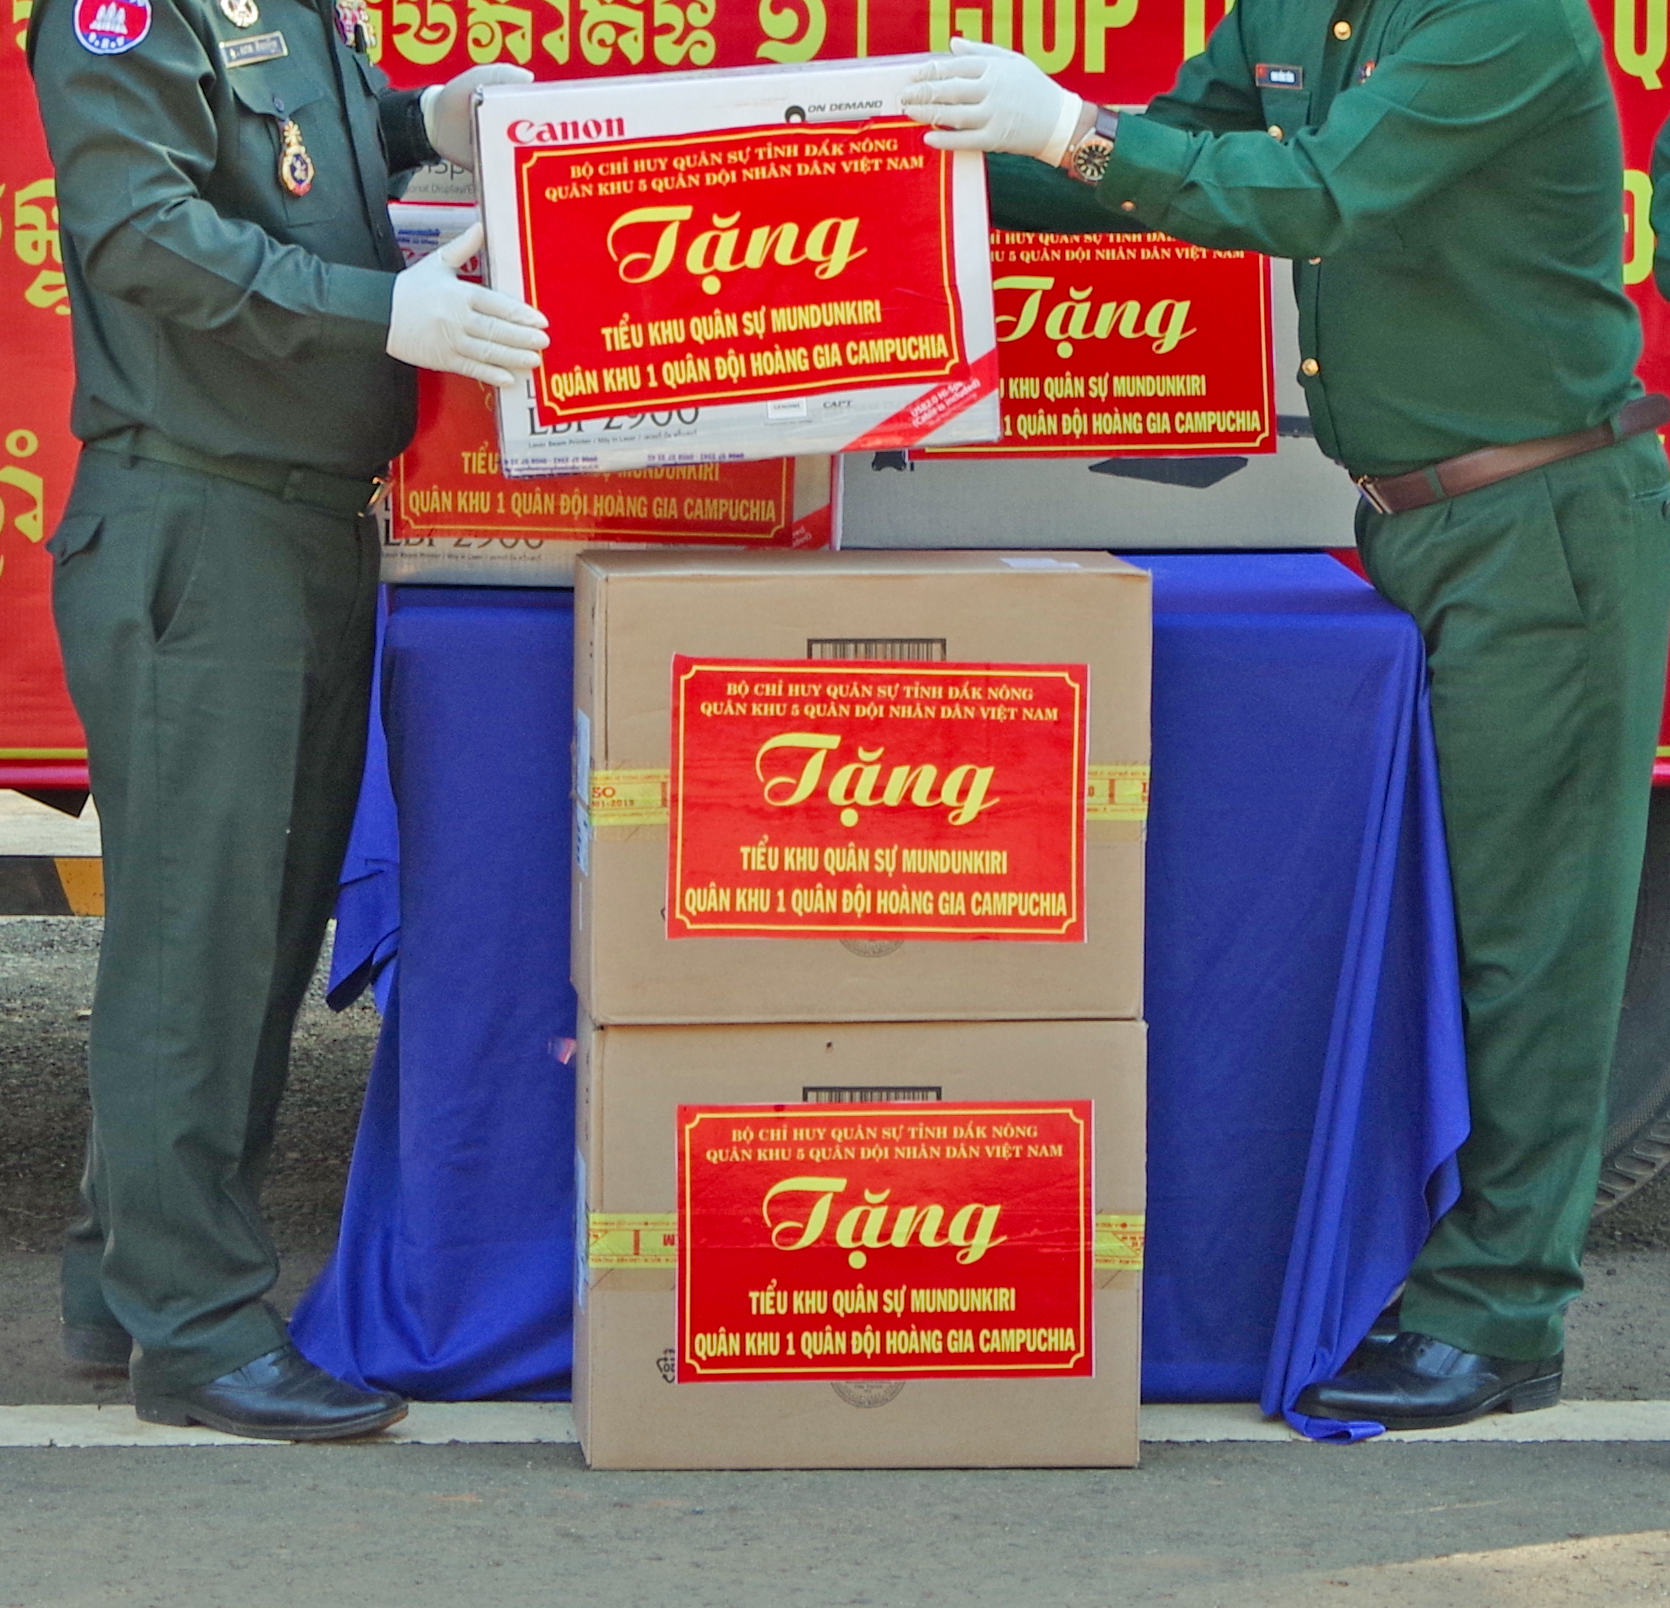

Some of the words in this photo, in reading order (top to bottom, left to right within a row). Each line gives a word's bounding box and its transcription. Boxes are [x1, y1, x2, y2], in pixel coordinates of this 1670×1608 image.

[807, 103, 826, 113] ON
[829, 100, 883, 112] DEMAND
[507, 116, 625, 144] Canon
[570, 161, 594, 179] BỘ
[598, 156, 628, 176] CHỈ
[633, 157, 668, 173] HUY
[672, 150, 724, 170] QUÂN
[727, 146, 750, 164] SỰ
[754, 142, 798, 161] TỈNH
[804, 138, 844, 157] ĐẮK
[849, 137, 898, 156] NÔNG
[544, 182, 592, 202] QUÂN
[597, 179, 633, 196] KHU
[638, 178, 647, 192] 5
[651, 172, 700, 193] QUÂN
[705, 168, 737, 186] ĐỘI
[742, 163, 792, 181] NHÂN
[796, 161, 835, 176] DÂN
[841, 157, 883, 174] VIỆT
[887, 154, 924, 170] NAM
[606, 204, 868, 295] Tặng
[600, 320, 644, 351] TIỂU
[647, 317, 685, 346] KHU
[689, 312, 739, 345] QUÂN
[741, 308, 766, 339] SỰ
[770, 299, 882, 333] MUNDUNKIRI
[548, 366, 599, 404] QUÂN
[602, 364, 641, 393] KHU
[646, 362, 659, 388] 1
[662, 352, 712, 389] QUÂN
[714, 349, 747, 383] ĐỘI
[750, 345, 810, 377] HOÀNG
[812, 341, 843, 370] GIA
[845, 332, 948, 366] CAMPUCHIA
[1008, 376, 1040, 399] KHU
[1043, 371, 1085, 402] QUÂN
[1088, 372, 1110, 402] SỰ
[1112, 373, 1206, 398] MUNDUNKIRI
[1003, 414, 1013, 436] 1
[1016, 408, 1058, 439] QUÂN
[1061, 407, 1088, 439] ĐỘI
[1091, 407, 1143, 435] HOÀNG
[1145, 411, 1171, 434] GIA
[1174, 409, 1261, 436] CAMPUCHIA
[726, 680, 750, 702] BỘ
[753, 680, 783, 697] CHỈ
[788, 682, 822, 697] HUY
[826, 681, 873, 700] QUÂN
[877, 682, 900, 701] SỰ
[902, 681, 943, 699] TỈNH
[948, 682, 983, 700] ĐẮK
[987, 683, 1034, 700] NÔNG
[699, 699, 747, 717] QUÂN
[751, 701, 787, 716] KHU
[791, 702, 800, 716] 5
[803, 701, 850, 718] QUÂN
[855, 701, 884, 720] ĐỘI
[889, 702, 936, 719] NHÂN
[940, 702, 976, 719] DÂN
[979, 703, 1018, 722] VIỆT
[1022, 706, 1058, 721] NAM
[754, 730, 1000, 828] Tặng
[738, 836, 780, 872] TIỂU
[783, 845, 820, 872] KHU
[823, 840, 871, 876] QUÂN
[873, 842, 899, 878] SỰ
[901, 847, 1008, 875] MUNDUNKIRI
[682, 883, 731, 919] QUÂN
[735, 886, 771, 913] KHU
[776, 887, 787, 913] 1
[790, 884, 838, 917] QUÂN
[841, 884, 872, 919] ĐỘI
[876, 884, 935, 916] HOÀNG
[937, 889, 967, 916] GIA
[970, 890, 1068, 918] CAMPUCHIA
[761, 1174, 1008, 1269] Tặng
[747, 1280, 788, 1315] TIỂU
[792, 1289, 828, 1315] KHU
[831, 1282, 879, 1318] QUÂN
[882, 1283, 907, 1318] SỰ
[909, 1286, 1016, 1313] MUNDUNKIRI
[692, 1328, 740, 1363] QUÂN
[744, 1331, 780, 1356] KHU
[785, 1331, 796, 1356] 1
[799, 1326, 847, 1359] QUÂN
[850, 1326, 881, 1359] ĐỘI
[884, 1325, 943, 1354] HOÀNG
[945, 1328, 975, 1353] GIA
[978, 1327, 1075, 1356] CAMPUCHIA
